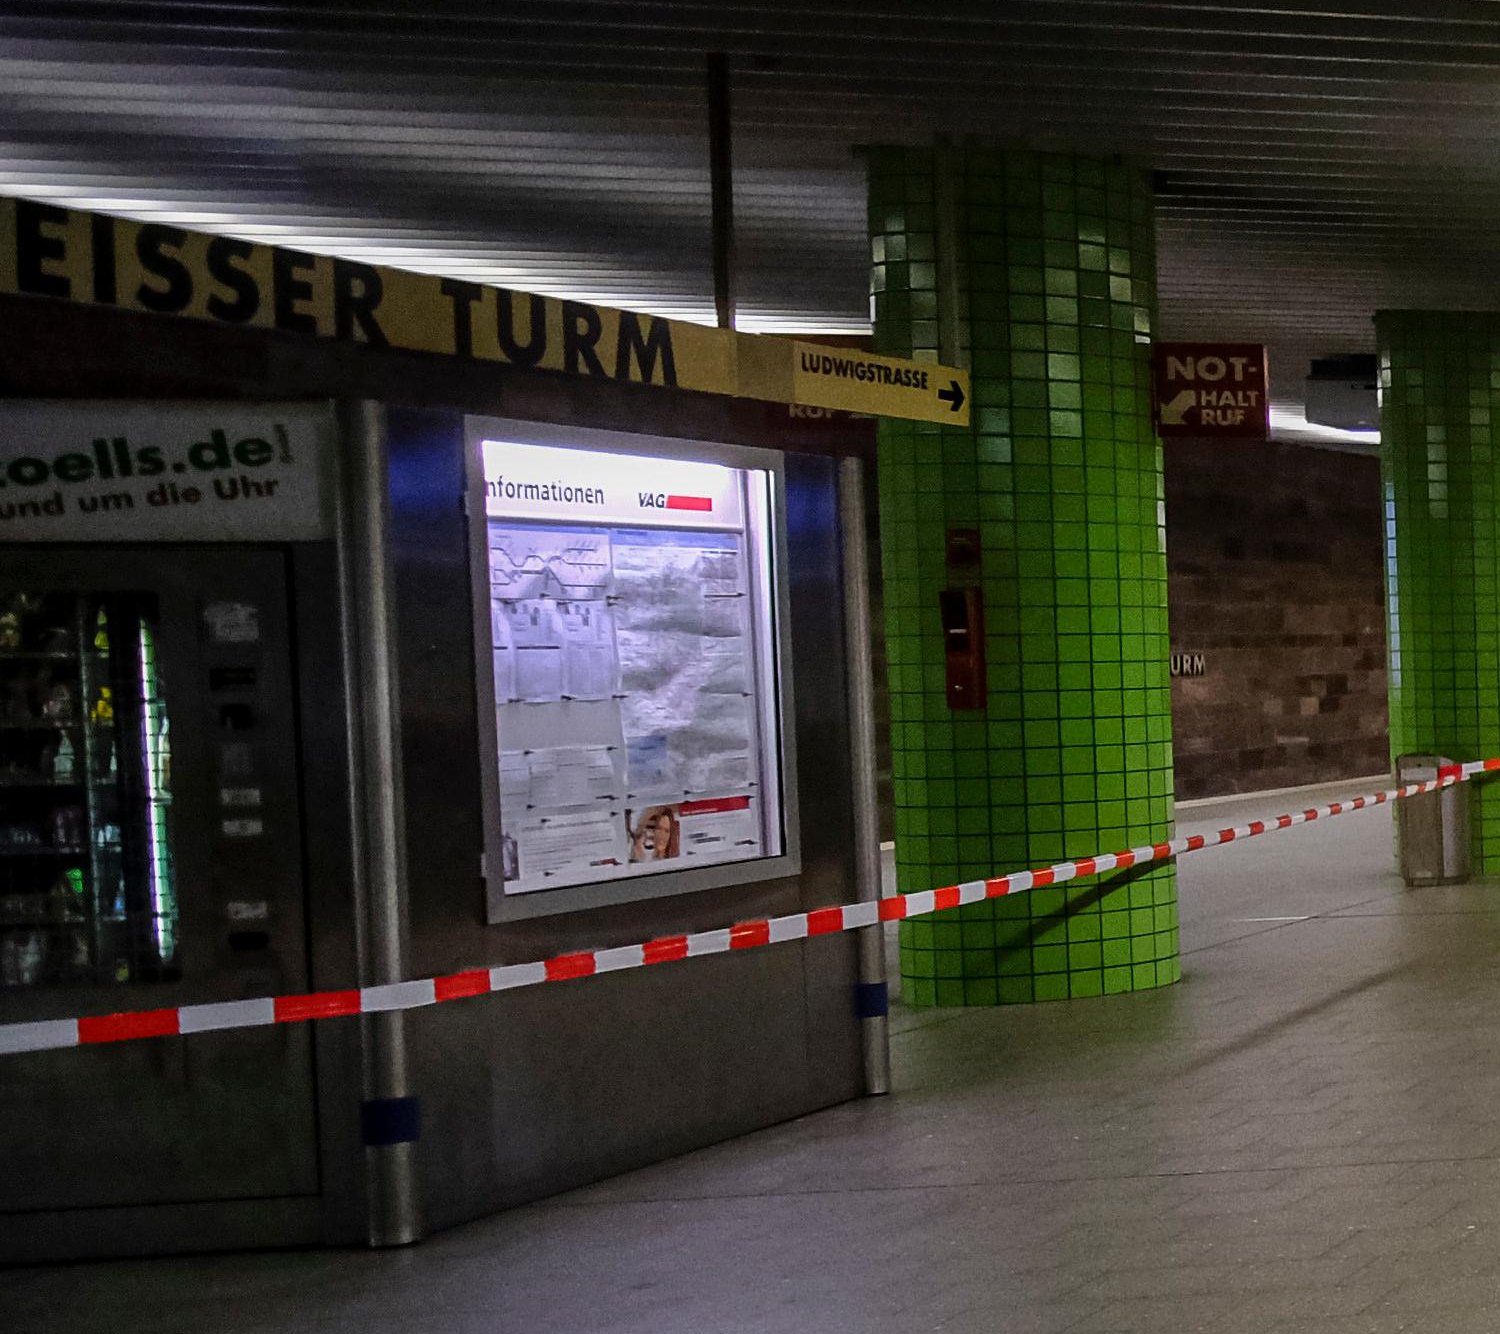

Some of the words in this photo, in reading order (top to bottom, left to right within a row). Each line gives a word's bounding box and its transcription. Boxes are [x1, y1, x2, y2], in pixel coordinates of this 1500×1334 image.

[15, 196, 391, 348] EISSER
[440, 276, 678, 389] TURM
[801, 352, 928, 390] LUDWIGSTRASSE
[1166, 355, 1257, 382] NOT-
[1201, 390, 1260, 407] HALT
[1201, 409, 1245, 426] RUF
[78, 490, 134, 513] um
[146, 482, 201, 507] die
[213, 475, 279, 501] Uhr
[638, 492, 666, 509] VAG
